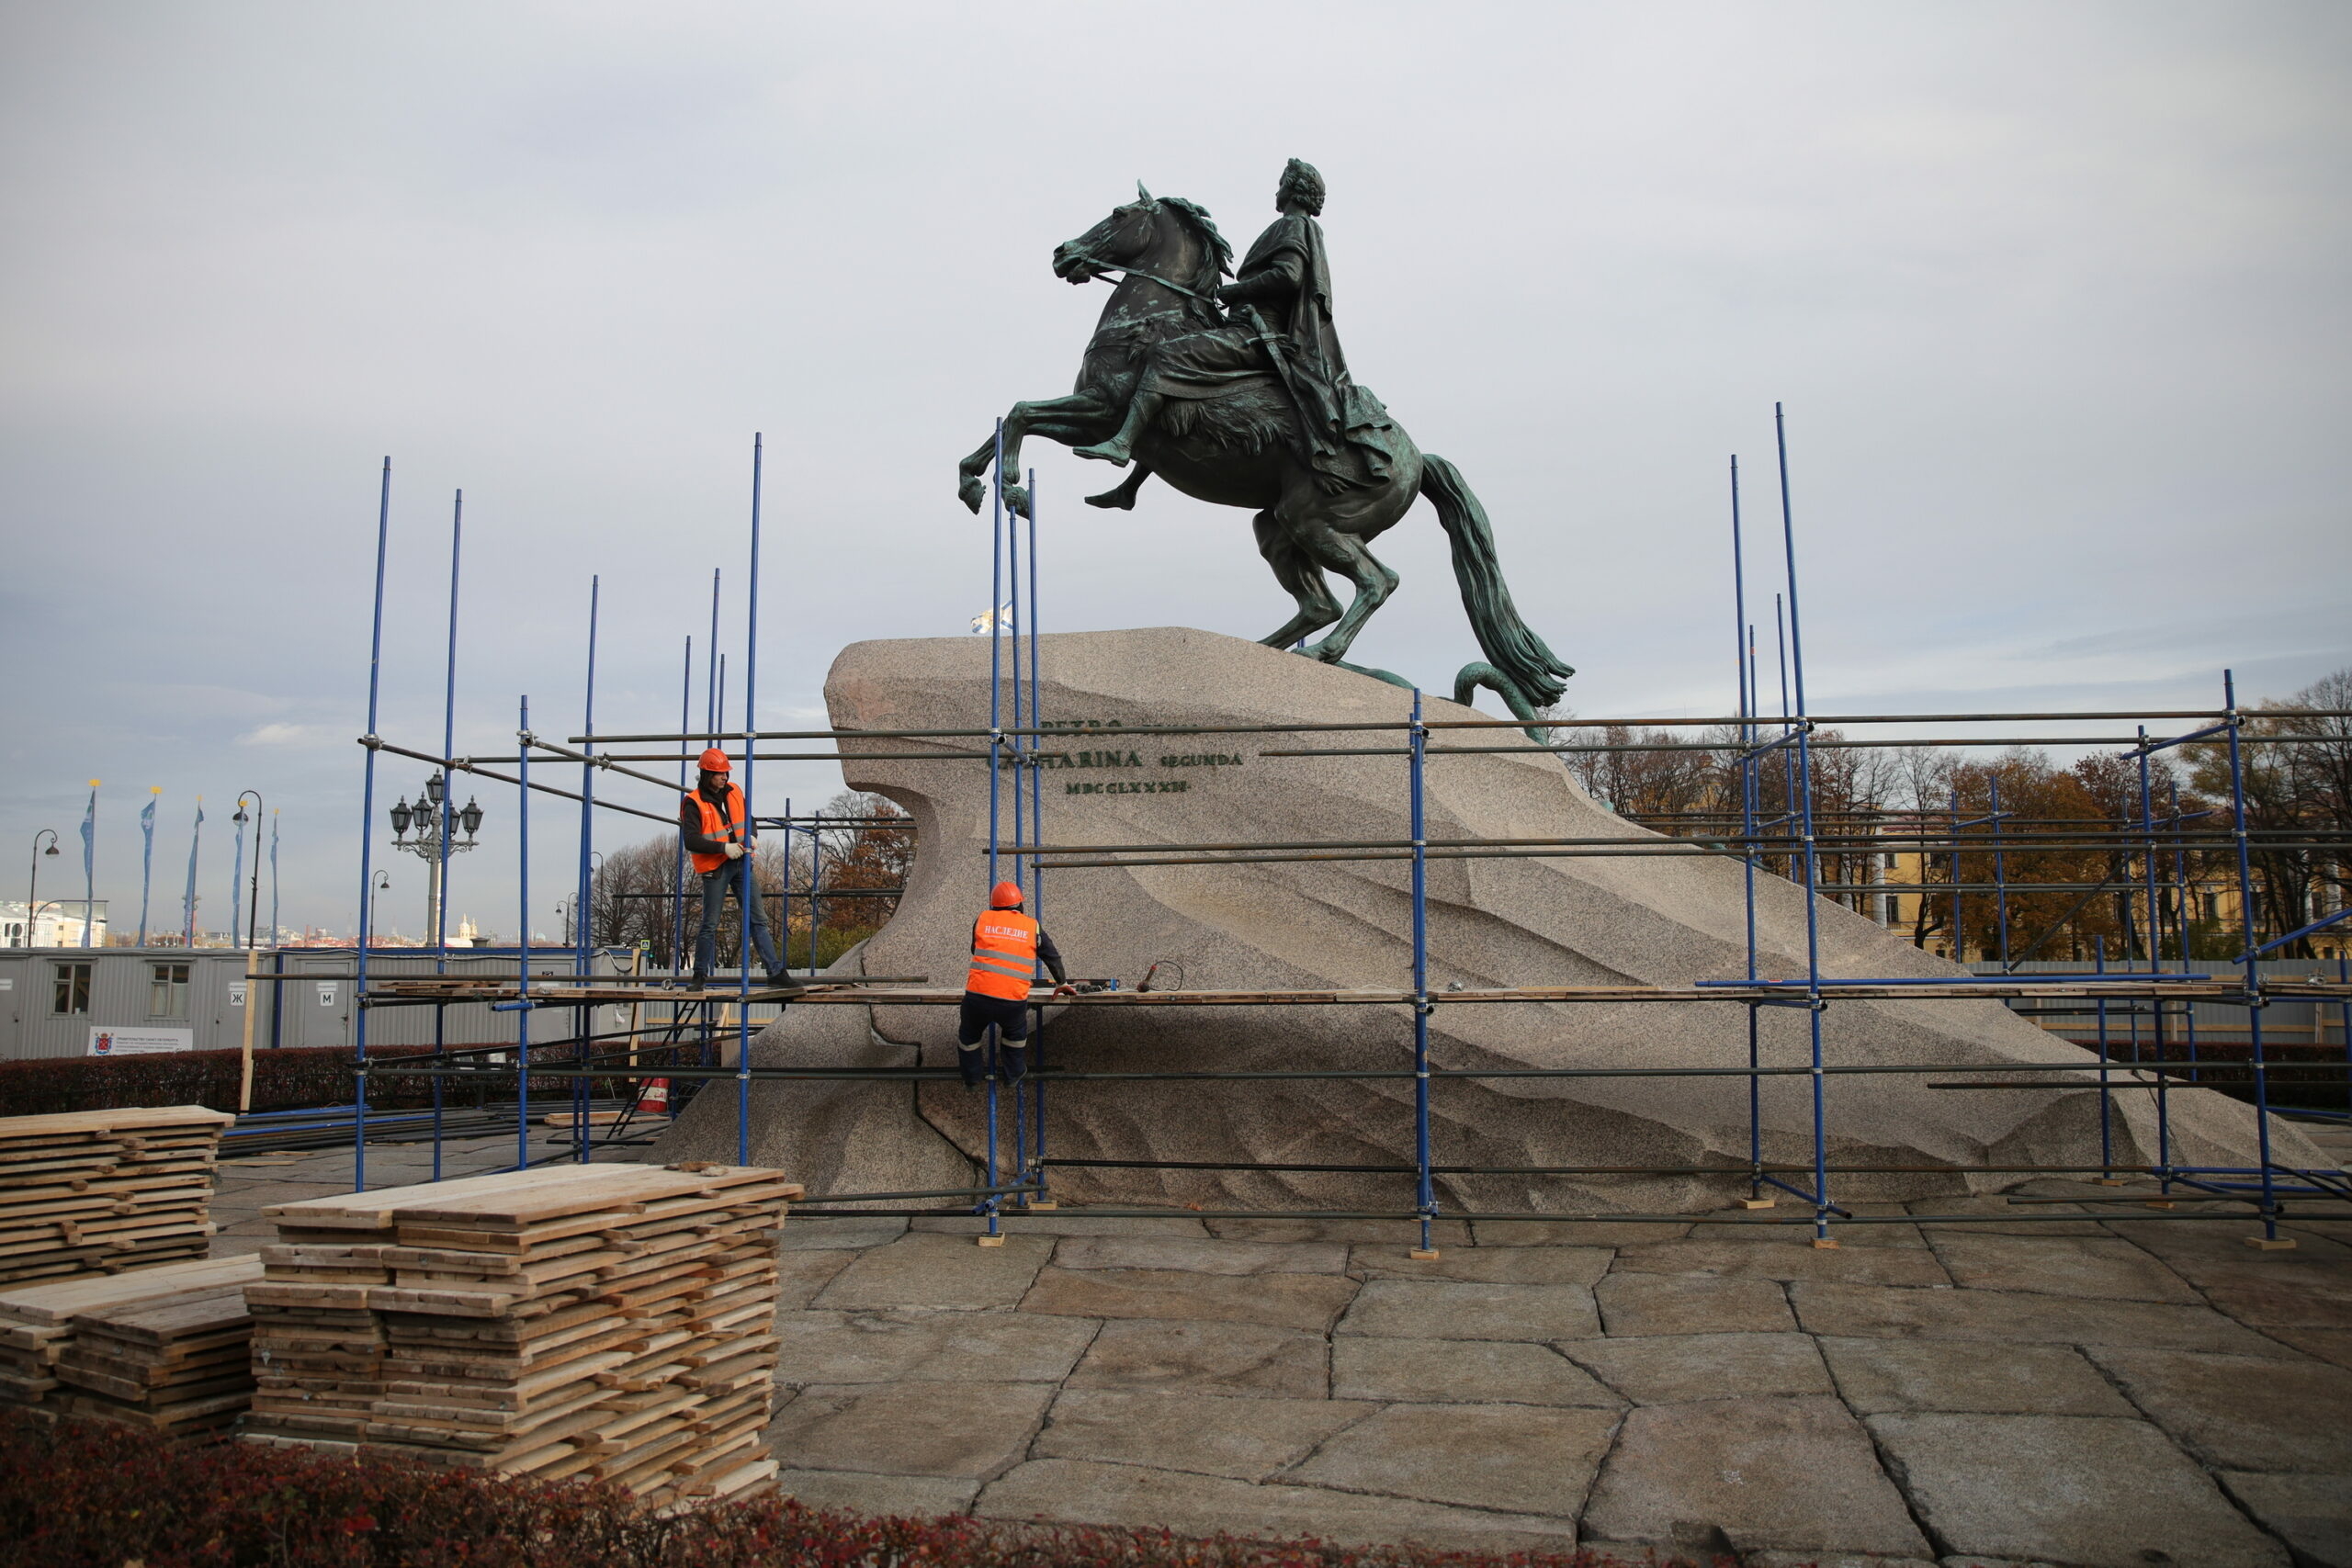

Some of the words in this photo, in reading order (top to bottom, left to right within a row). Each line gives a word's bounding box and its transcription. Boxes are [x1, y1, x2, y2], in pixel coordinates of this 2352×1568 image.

[1160, 753, 1244, 768] SECUNDA
[984, 925, 1028, 939] НАСЛЕДИЕ
[232, 993, 243, 1004] Ж
[322, 994, 332, 1004] М
